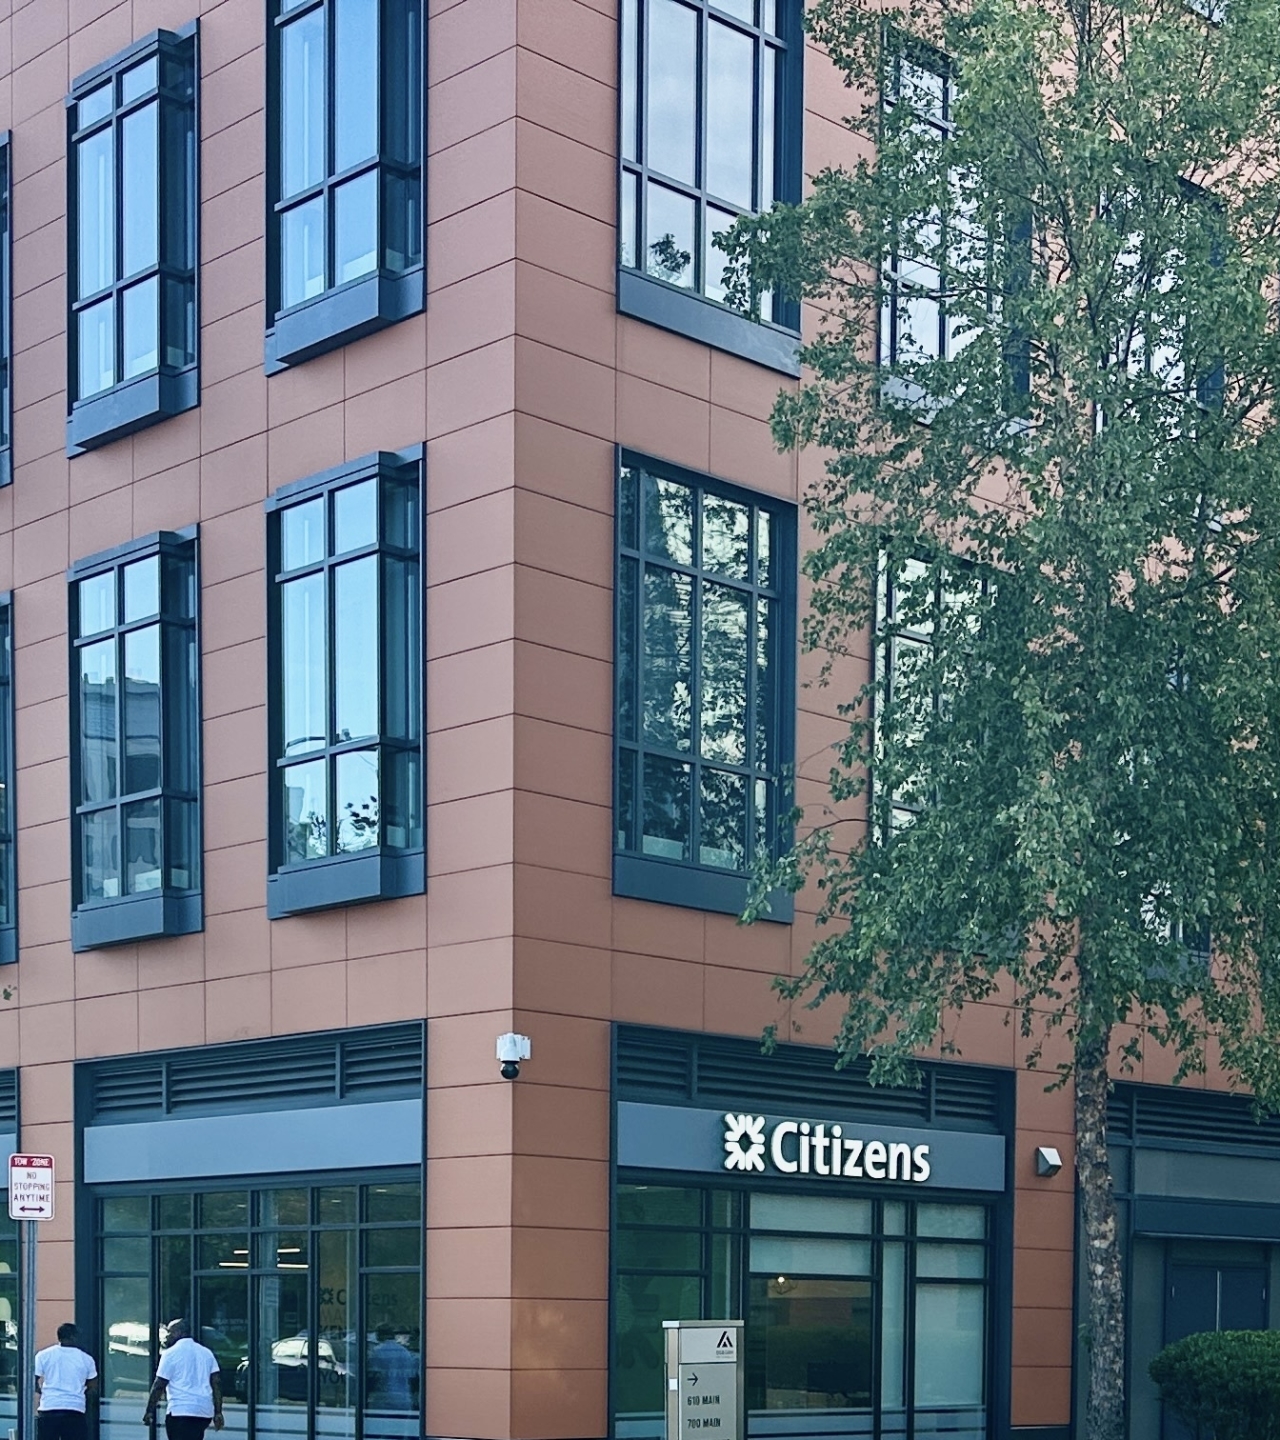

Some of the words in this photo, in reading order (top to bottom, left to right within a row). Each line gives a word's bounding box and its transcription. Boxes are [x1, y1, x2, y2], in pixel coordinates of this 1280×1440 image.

[771, 1121, 930, 1182] Citizens
[26, 1171, 37, 1180] NO
[13, 1182, 50, 1191] STOPPING
[13, 1193, 50, 1202] ANYTIME
[687, 1395, 700, 1406] 610
[702, 1394, 720, 1405] MAIN
[702, 1417, 721, 1428] MAIN
